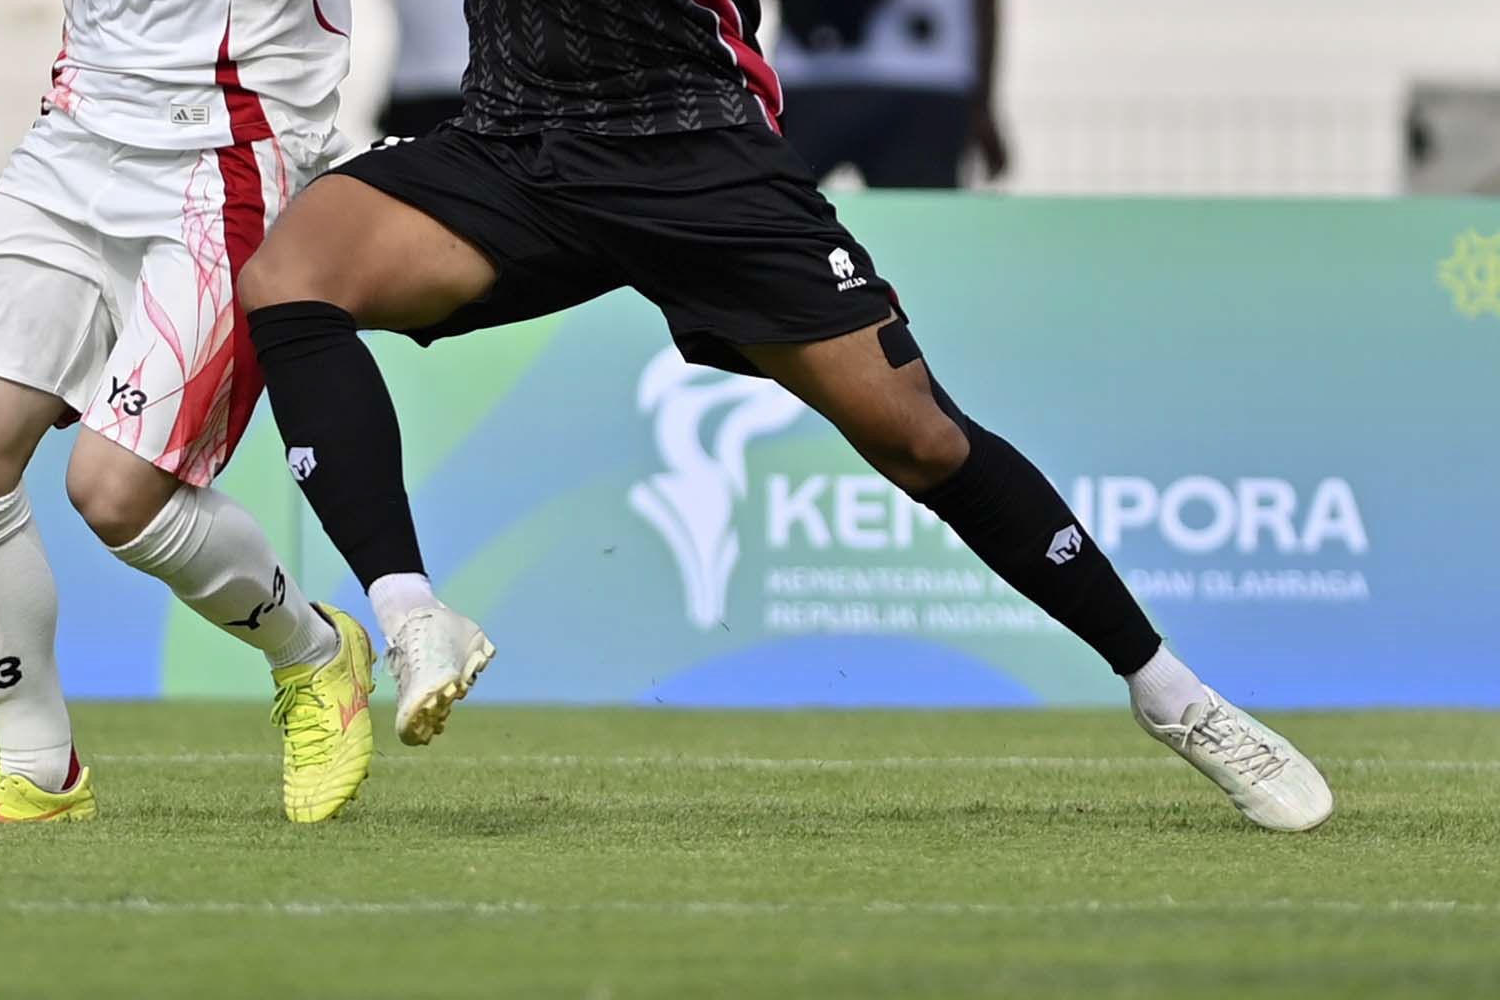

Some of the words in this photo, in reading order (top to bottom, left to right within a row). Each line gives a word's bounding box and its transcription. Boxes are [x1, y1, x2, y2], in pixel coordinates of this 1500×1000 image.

[107, 375, 148, 417] Y-3
[766, 473, 1370, 555] KEMPORA
[768, 567, 983, 596] KEMENTERIAN
[1202, 569, 1371, 600] OLAHRAGA
[770, 601, 918, 630] REPUBLIK
